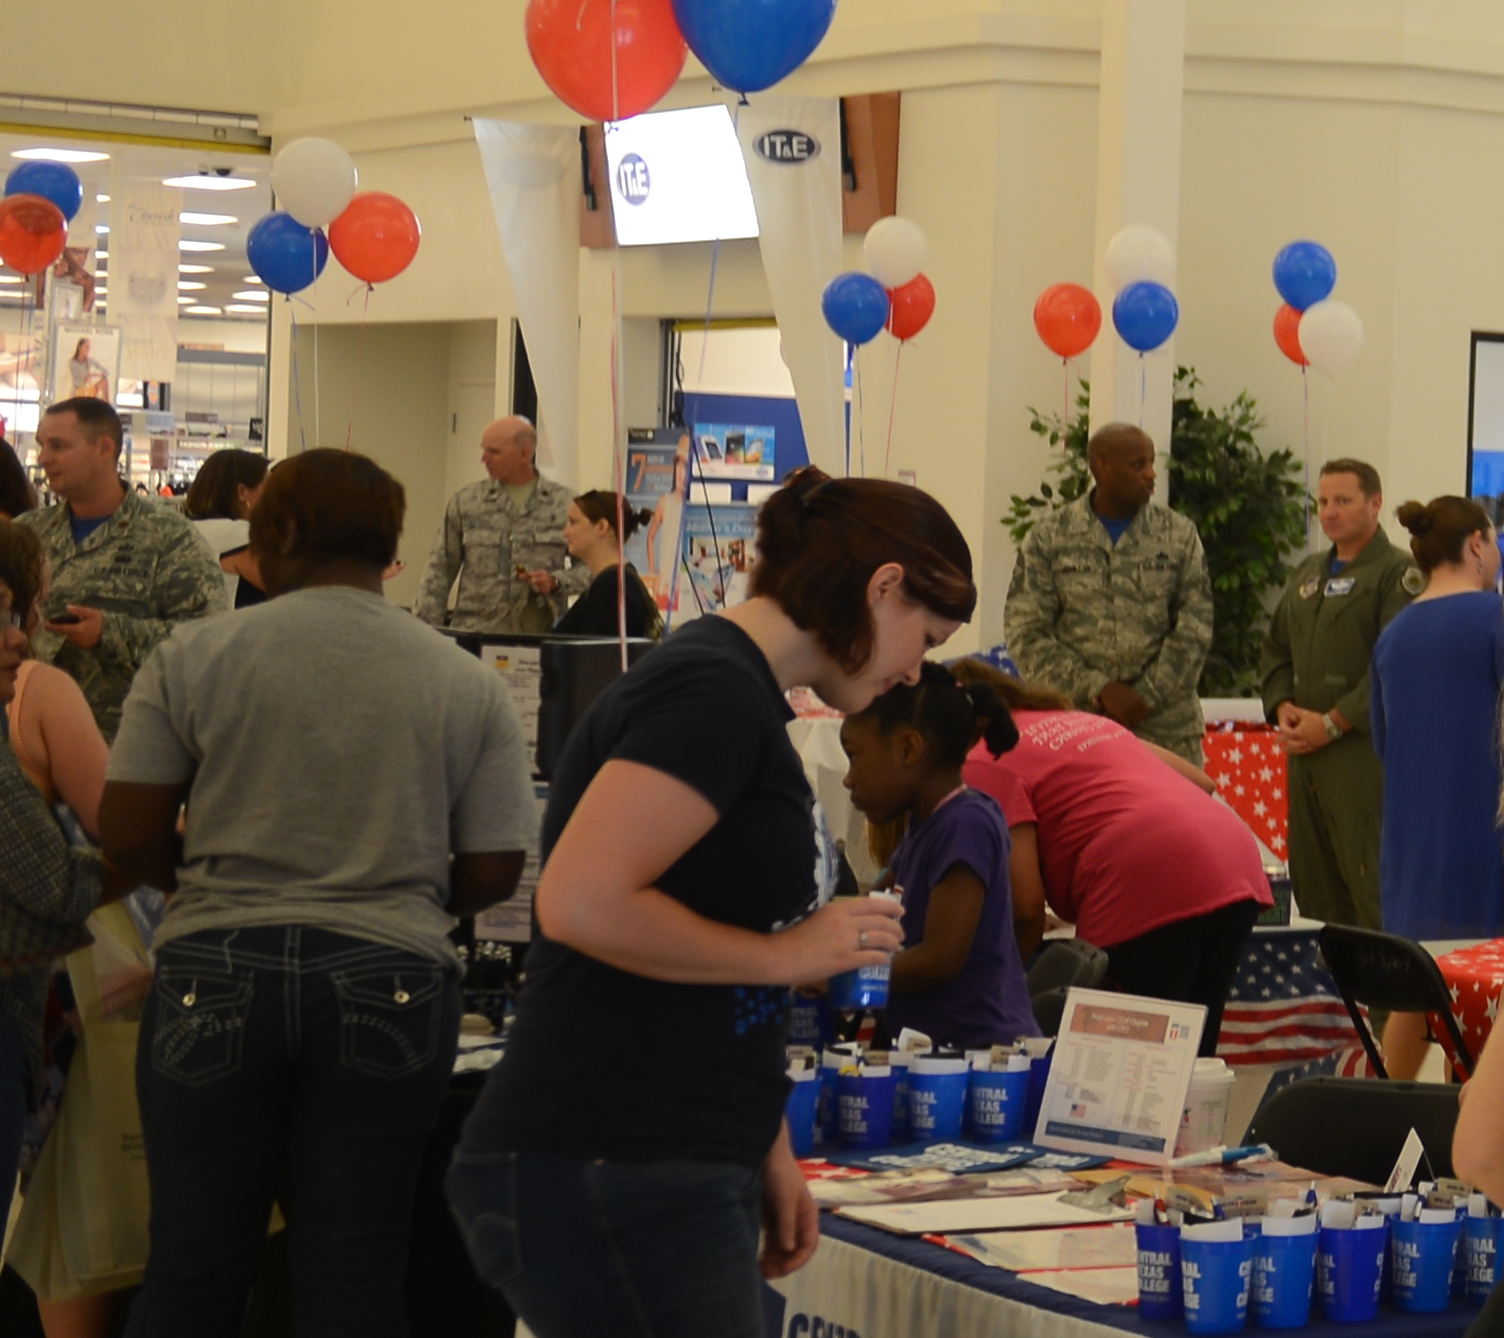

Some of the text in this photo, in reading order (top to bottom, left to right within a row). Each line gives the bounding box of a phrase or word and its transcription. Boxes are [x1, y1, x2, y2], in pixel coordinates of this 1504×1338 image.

[763, 135, 809, 160] IT&E
[619, 162, 649, 197] IT&E
[973, 1112, 1006, 1126] LLEGE
[1138, 1251, 1172, 1267] NTRAL
[1138, 1265, 1164, 1279] EXAS
[1138, 1278, 1170, 1293] LLEGE
